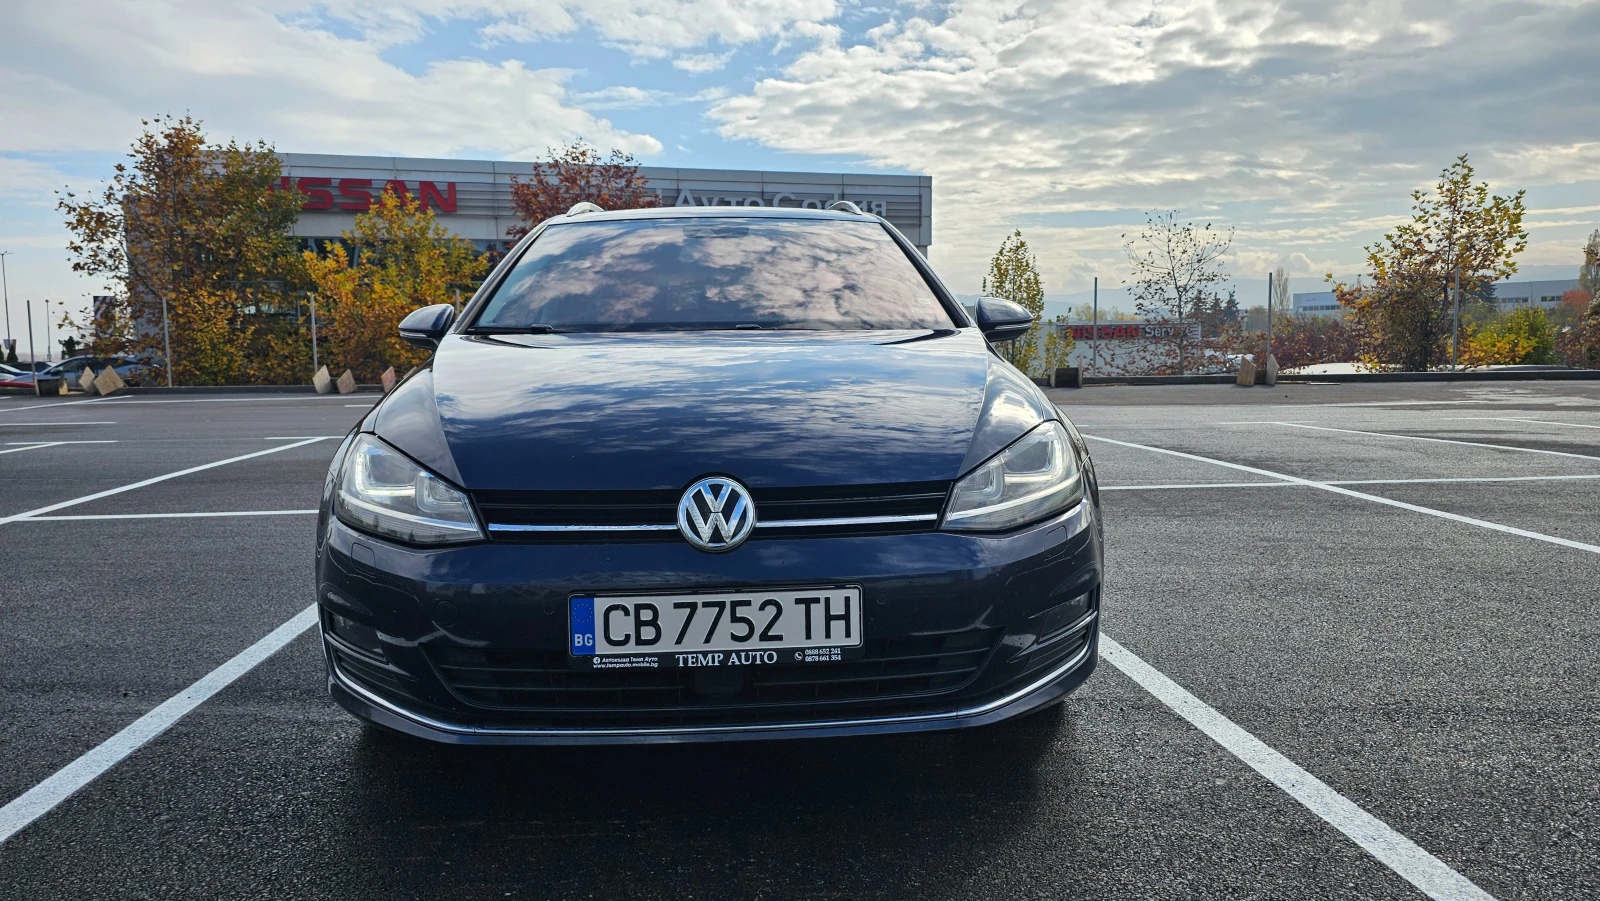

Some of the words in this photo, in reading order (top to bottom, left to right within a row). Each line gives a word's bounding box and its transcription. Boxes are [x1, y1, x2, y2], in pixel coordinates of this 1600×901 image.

[603, 603, 662, 647] CB
[672, 598, 784, 645] 7752
[794, 595, 852, 641] TH
[574, 633, 593, 647] BG
[675, 653, 723, 668] TEMP
[727, 651, 778, 666] AUTO
